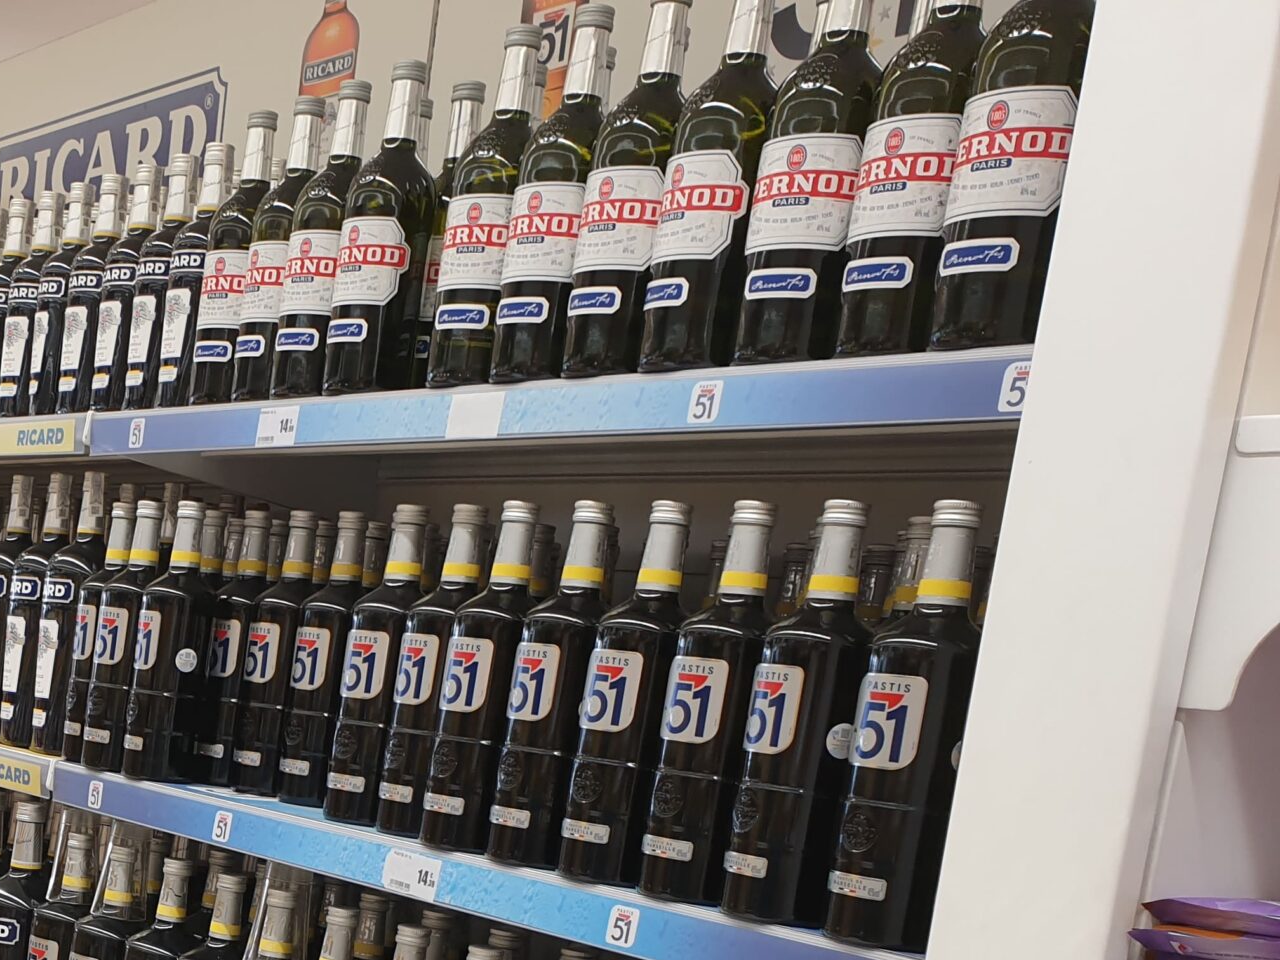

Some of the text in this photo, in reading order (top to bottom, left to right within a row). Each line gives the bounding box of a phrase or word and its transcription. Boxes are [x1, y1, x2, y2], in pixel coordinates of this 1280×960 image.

[537, 14, 569, 65] 51
[305, 54, 353, 80] RICARD
[973, 159, 1008, 171] PARIS
[872, 182, 904, 192] PARIS
[16, 427, 64, 447] RICARD
[96, 623, 119, 661] 51
[246, 640, 268, 679] 51
[292, 646, 319, 686] 51
[343, 650, 376, 694] 51
[395, 654, 426, 700] 51
[443, 657, 478, 707] 51
[676, 664, 715, 676] PASTIS
[867, 680, 912, 694] PASTIS
[509, 666, 546, 716] 51
[584, 673, 627, 726] 51
[665, 682, 713, 738] 51
[745, 689, 784, 748] 51
[855, 700, 909, 763] 51
